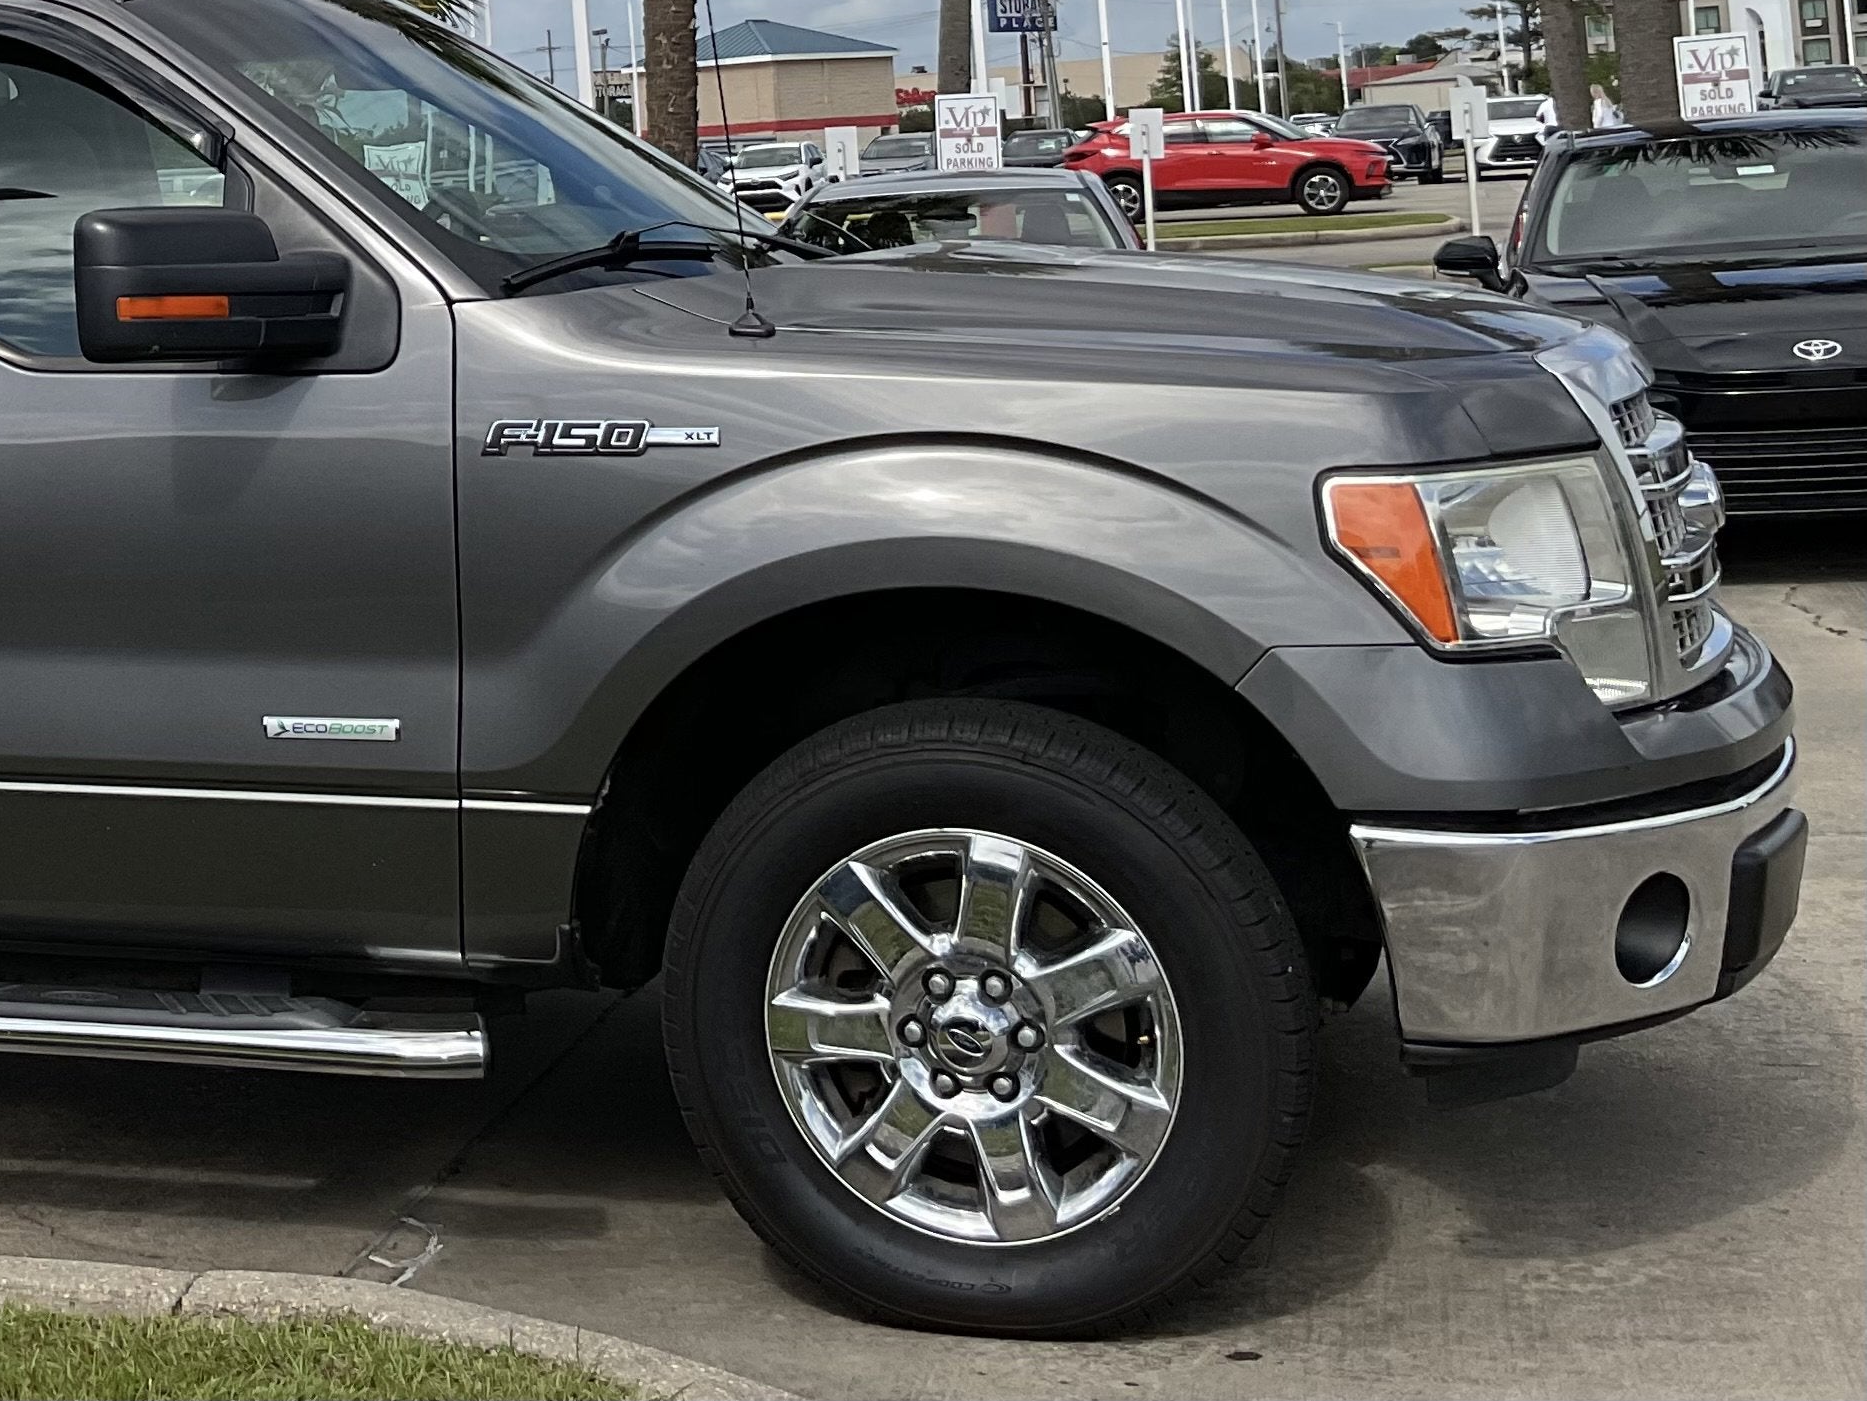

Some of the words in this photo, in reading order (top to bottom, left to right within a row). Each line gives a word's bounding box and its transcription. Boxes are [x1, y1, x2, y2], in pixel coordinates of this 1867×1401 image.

[1699, 87, 1734, 101] SOLD
[1690, 103, 1746, 117] PARKING
[955, 142, 984, 154] SOLD
[946, 157, 993, 169] PARKING
[482, 418, 652, 457] F-150
[684, 431, 713, 441] XLT
[292, 722, 389, 735] ECOBOOST
